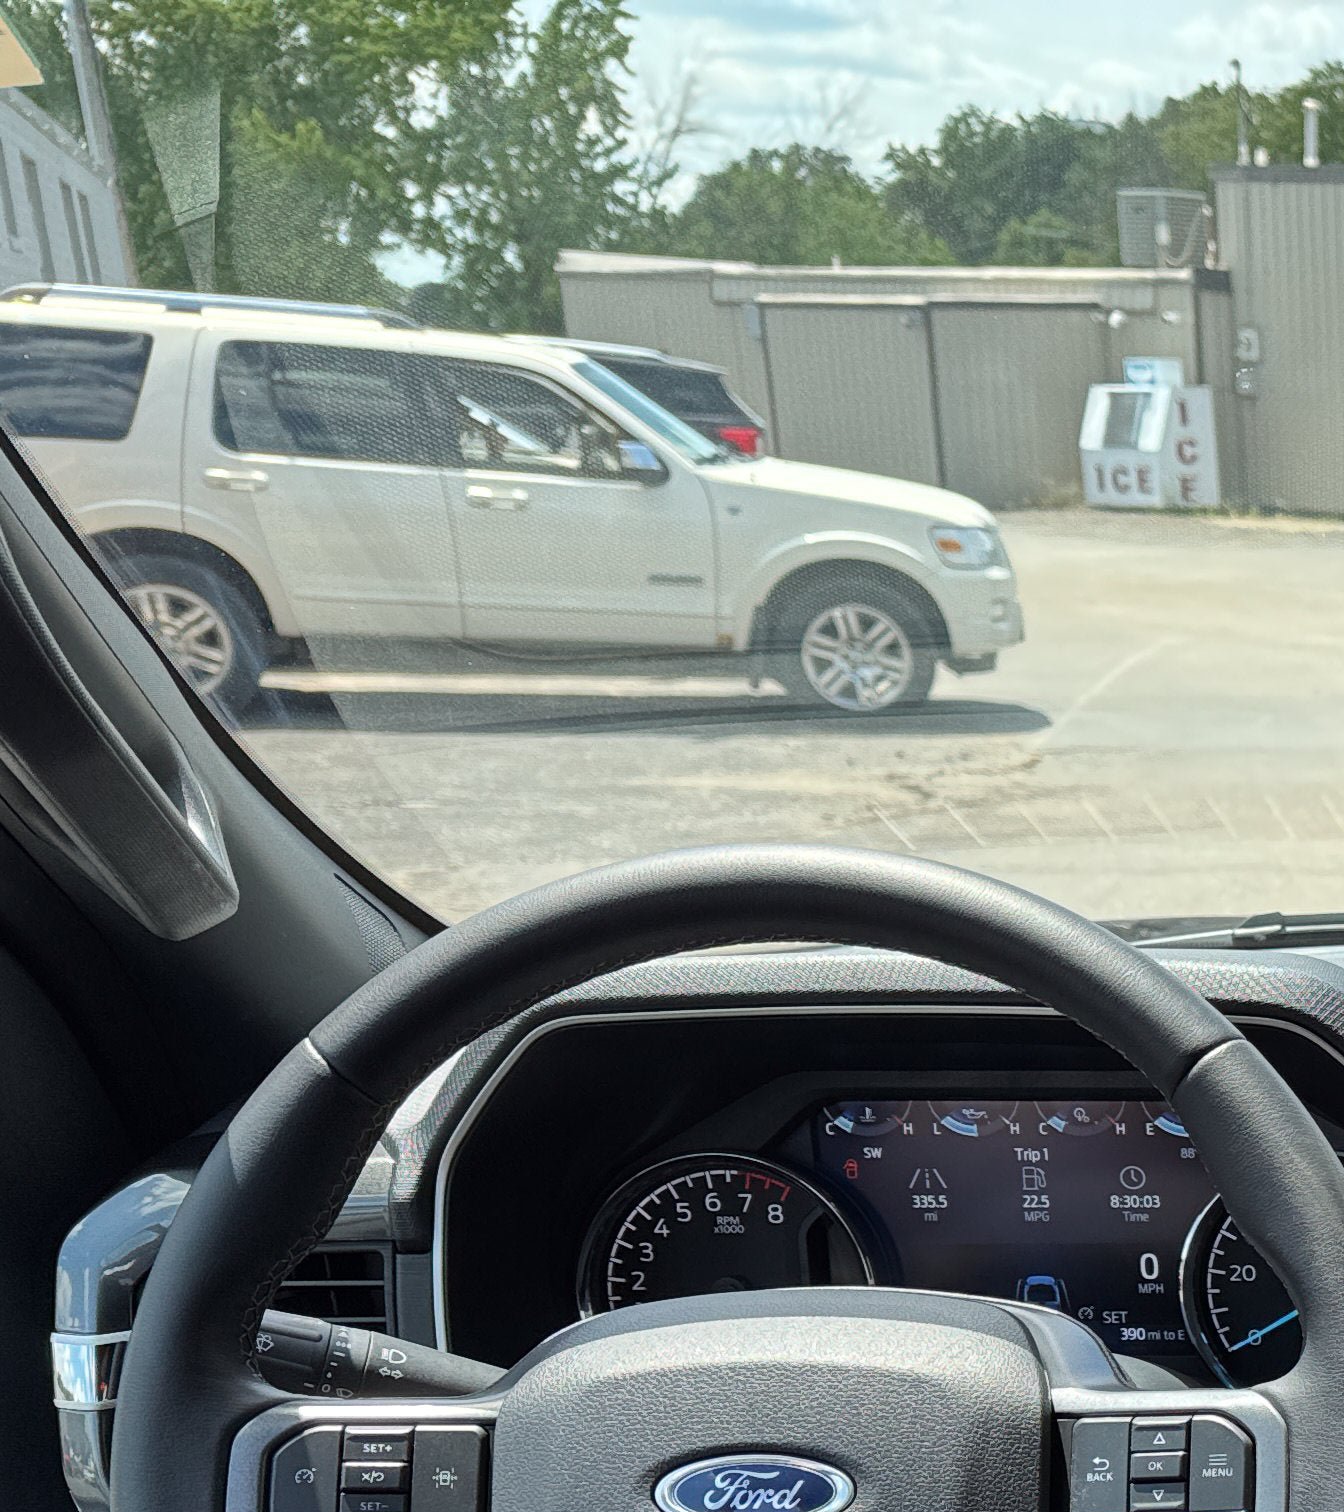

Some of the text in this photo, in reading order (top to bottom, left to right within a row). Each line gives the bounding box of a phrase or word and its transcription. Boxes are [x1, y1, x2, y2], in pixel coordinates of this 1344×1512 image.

[1093, 463, 1153, 495] ICE
[825, 1122, 834, 1135] C
[903, 1122, 913, 1135] H
[933, 1122, 942, 1135] L
[1009, 1122, 1019, 1135] H
[1039, 1122, 1048, 1135] C
[1115, 1122, 1126, 1135] H
[1146, 1122, 1155, 1135] E
[863, 1147, 882, 1159] SW
[1013, 1148, 1049, 1161] Trip 1
[705, 1192, 721, 1212] 6
[737, 1194, 752, 1213] 7
[911, 1195, 947, 1208] 335.5
[1022, 1195, 1049, 1208] 22.5
[1109, 1195, 1161, 1208] 8:30:03
[676, 1203, 692, 1222] 5
[768, 1204, 784, 1224] 8
[924, 1210, 938, 1221] mi
[1024, 1210, 1050, 1222] MPG
[1122, 1211, 1149, 1222] Time
[716, 1216, 740, 1225] RPM
[653, 1219, 670, 1237] 4
[714, 1225, 745, 1234] x1000
[639, 1243, 654, 1262] 3
[1139, 1253, 1159, 1280] 0
[1229, 1264, 1256, 1282] 20
[631, 1271, 647, 1290] 2
[1138, 1283, 1164, 1294] MPH
[1102, 1311, 1128, 1324] SET
[1120, 1328, 1185, 1341] 390 mi to E
[1148, 1461, 1163, 1471] OK
[1202, 1467, 1234, 1478] MENU
[1086, 1471, 1114, 1482] BACK
[703, 1468, 805, 1511] Ford
